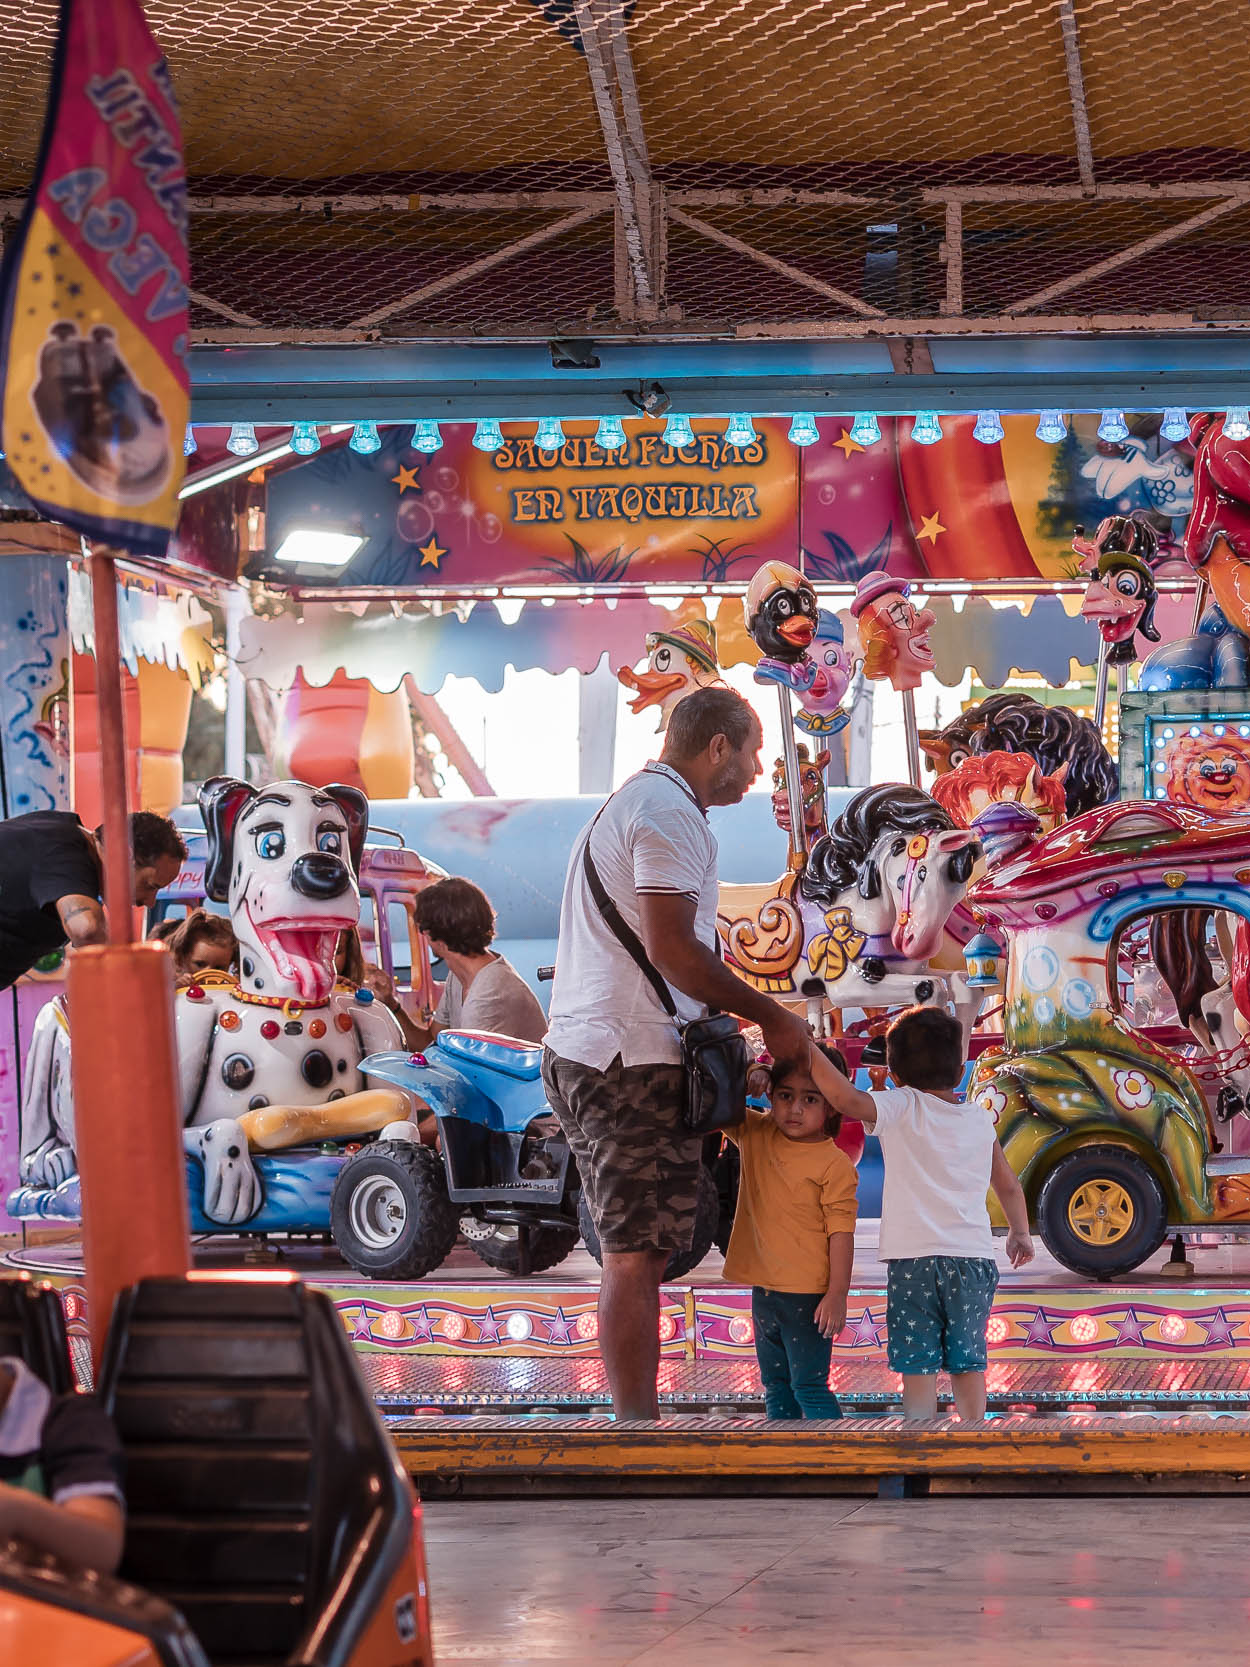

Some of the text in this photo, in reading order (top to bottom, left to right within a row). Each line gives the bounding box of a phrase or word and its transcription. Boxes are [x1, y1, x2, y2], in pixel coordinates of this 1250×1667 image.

[640, 435, 765, 470] FICHAS
[513, 485, 758, 522] EN TAQUILLA
